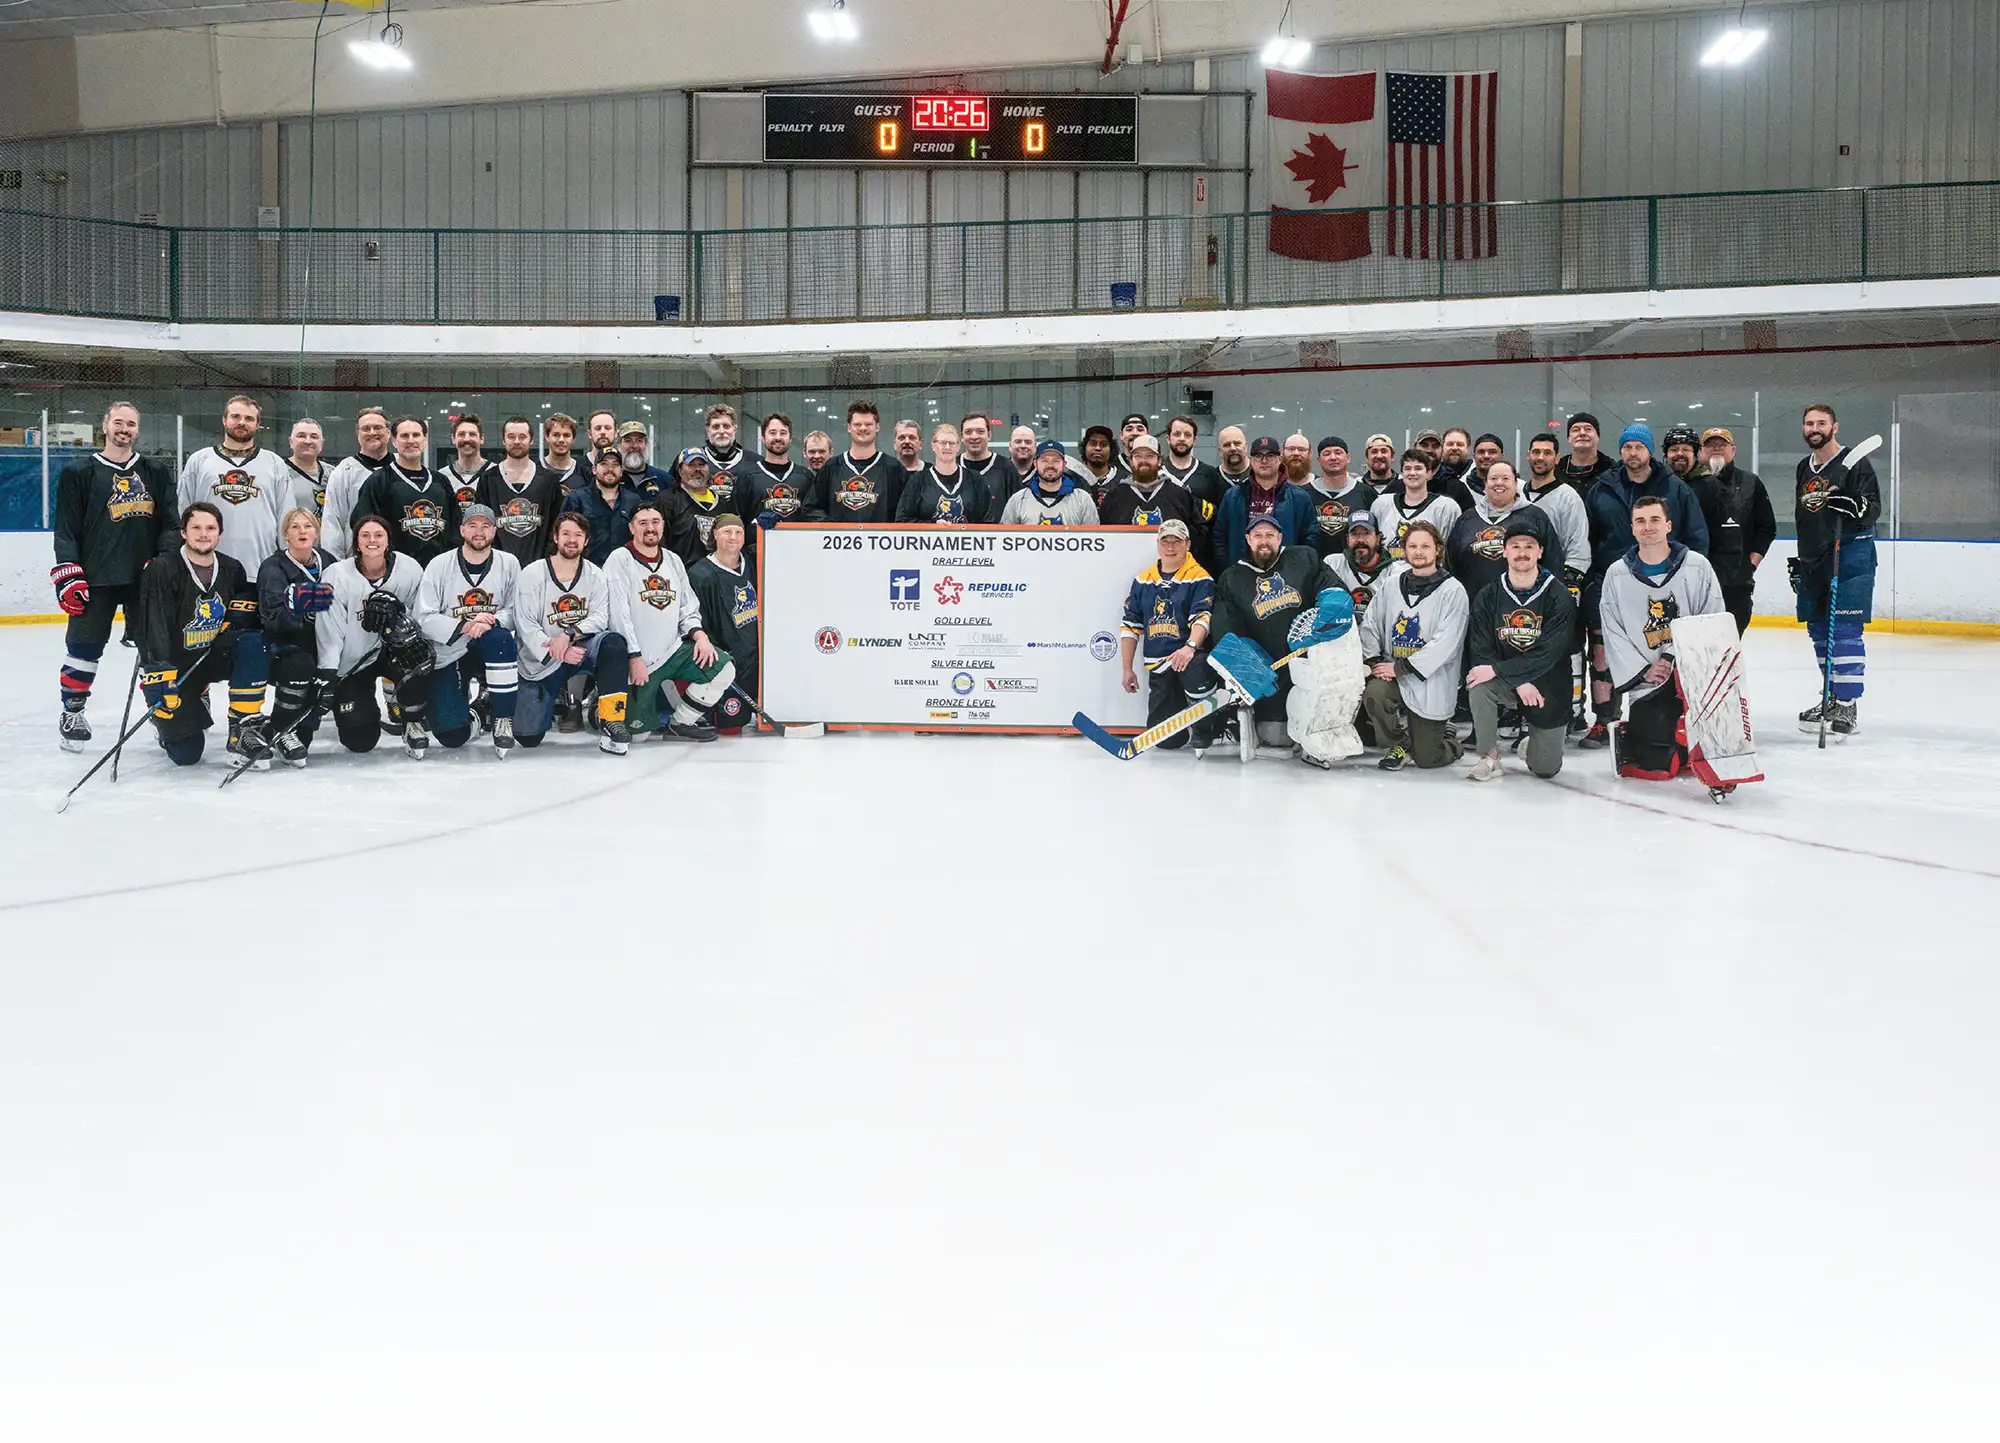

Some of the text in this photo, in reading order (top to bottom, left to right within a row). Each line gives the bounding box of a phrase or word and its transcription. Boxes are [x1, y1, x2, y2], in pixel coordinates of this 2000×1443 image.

[854, 105, 901, 116] GUEST
[916, 100, 985, 126] 20:26
[1003, 106, 1045, 117] HOME
[768, 124, 845, 132] PENALTY PLYR
[1056, 126, 1133, 134] PLYR PENALTY
[880, 123, 896, 150] 0
[1027, 124, 1043, 151] 0
[913, 143, 955, 153] PERIOD
[823, 536, 1105, 552] 2026 TOURNAMENT SPONSORS
[932, 558, 995, 567] DRAFT LEVEL
[968, 583, 1027, 592] REPUBLIC
[890, 602, 920, 611] TOTE
[934, 617, 992, 626] GOLD LEVEL
[859, 638, 902, 647] LYNDEN
[931, 660, 995, 669] SILVER LEVEL
[925, 699, 996, 708] BRONZE LEVEL
